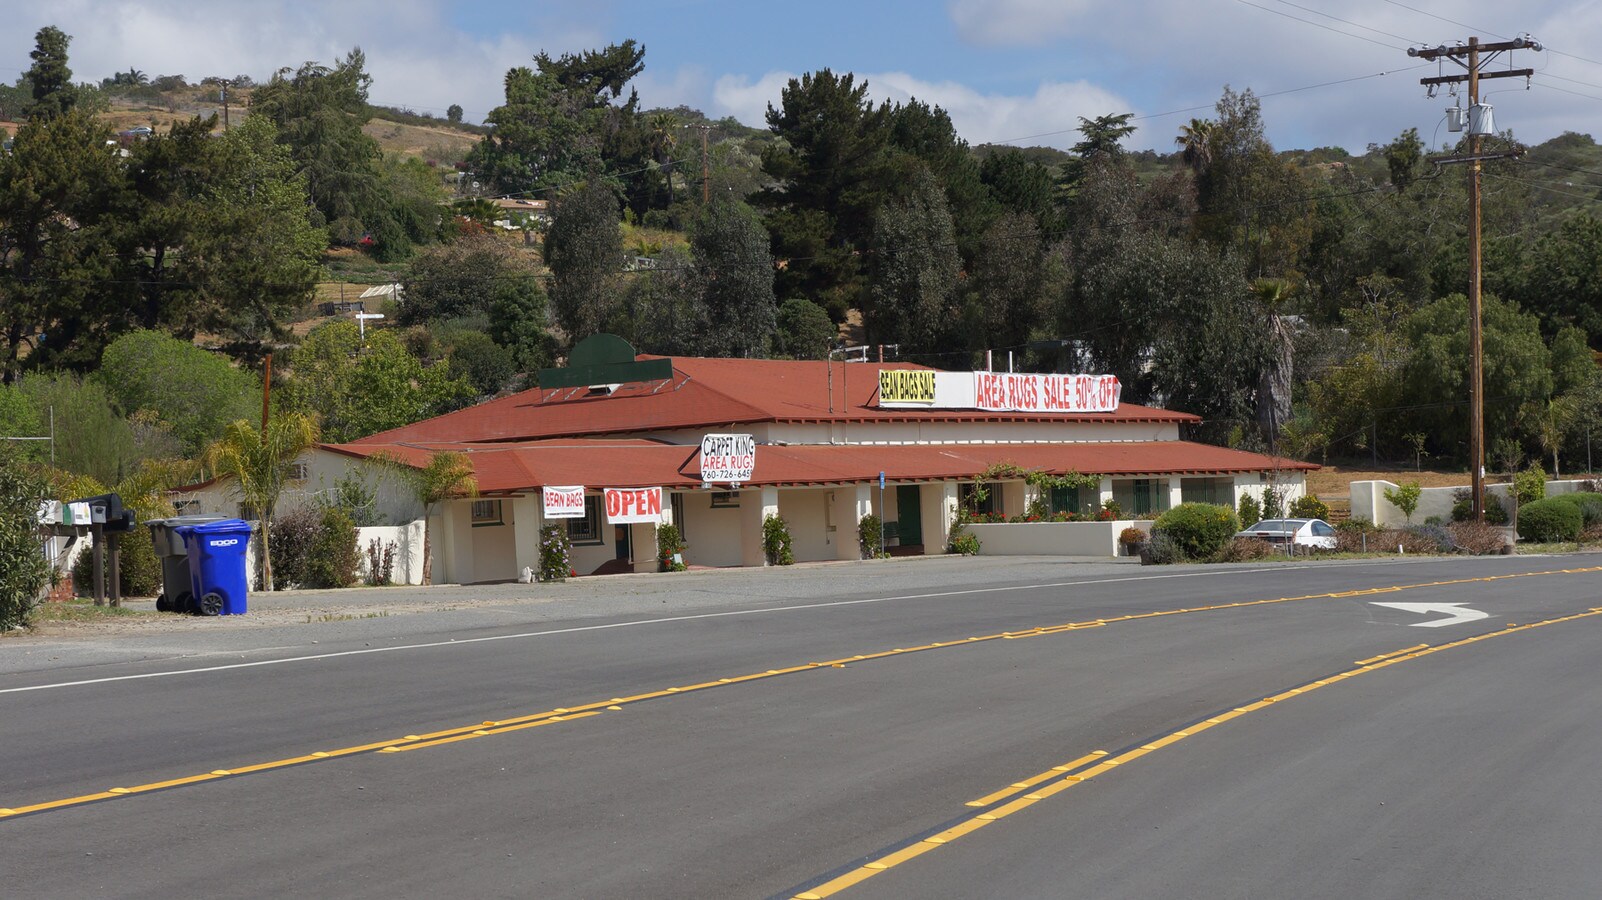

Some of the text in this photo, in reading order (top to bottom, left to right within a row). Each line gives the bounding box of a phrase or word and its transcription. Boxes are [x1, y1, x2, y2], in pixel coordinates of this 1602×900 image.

[880, 372, 936, 400] BEAN BAGS SALE
[976, 374, 1118, 410] AREA RUGS SALE 50% OFF
[703, 435, 754, 457] CARPET KING
[702, 455, 753, 470] AREA RUGS
[545, 491, 583, 507] BEAN BAGS
[606, 489, 661, 517] OPEN
